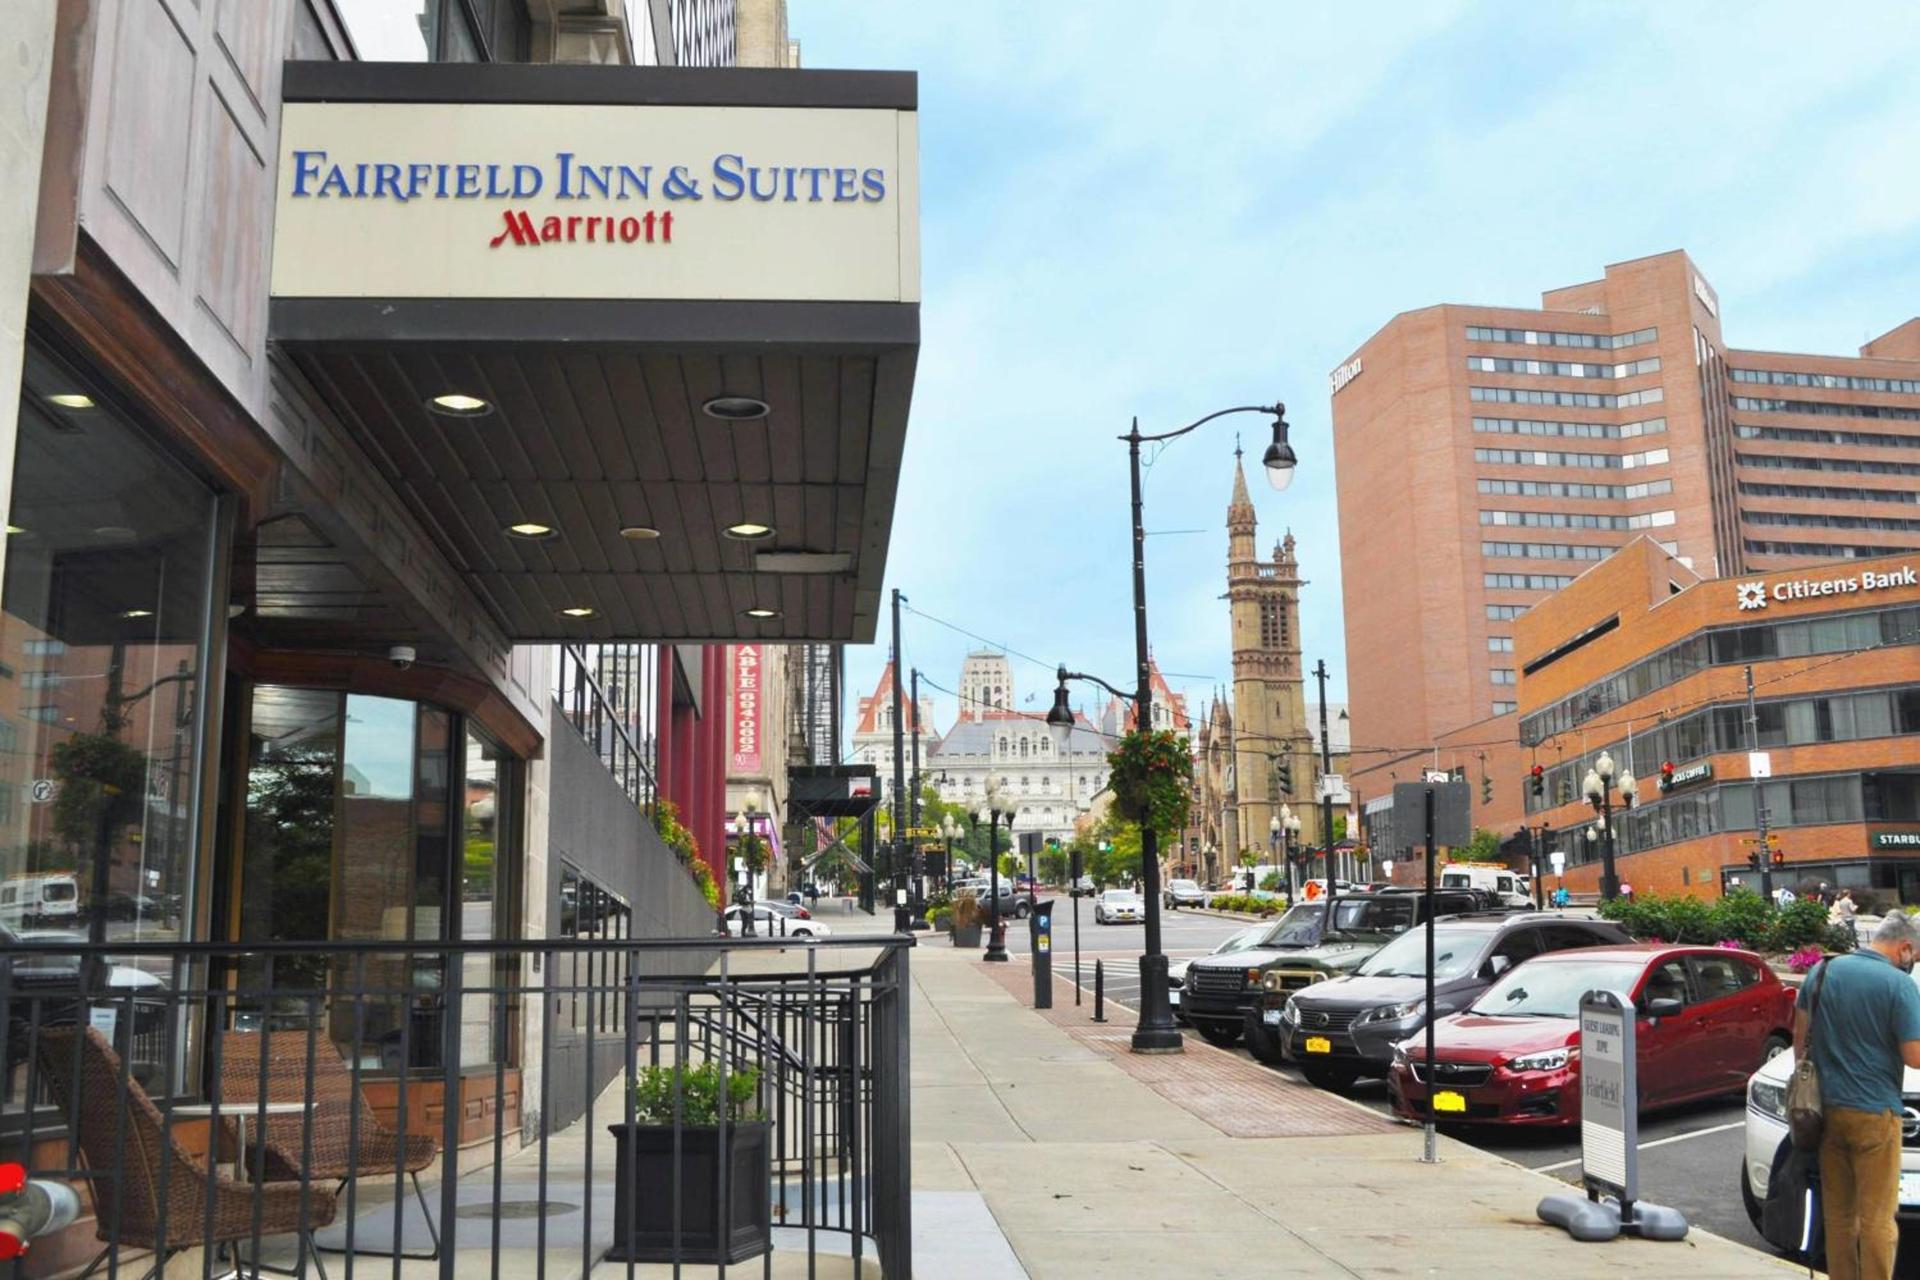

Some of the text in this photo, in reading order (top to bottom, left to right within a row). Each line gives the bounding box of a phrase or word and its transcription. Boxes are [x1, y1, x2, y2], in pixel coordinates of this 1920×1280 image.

[292, 149, 887, 203] FAIRFIELD INN & SUITES
[489, 209, 674, 248] Marriott
[1331, 357, 1362, 394] Hilton
[1773, 565, 1917, 601] Citizens Bank
